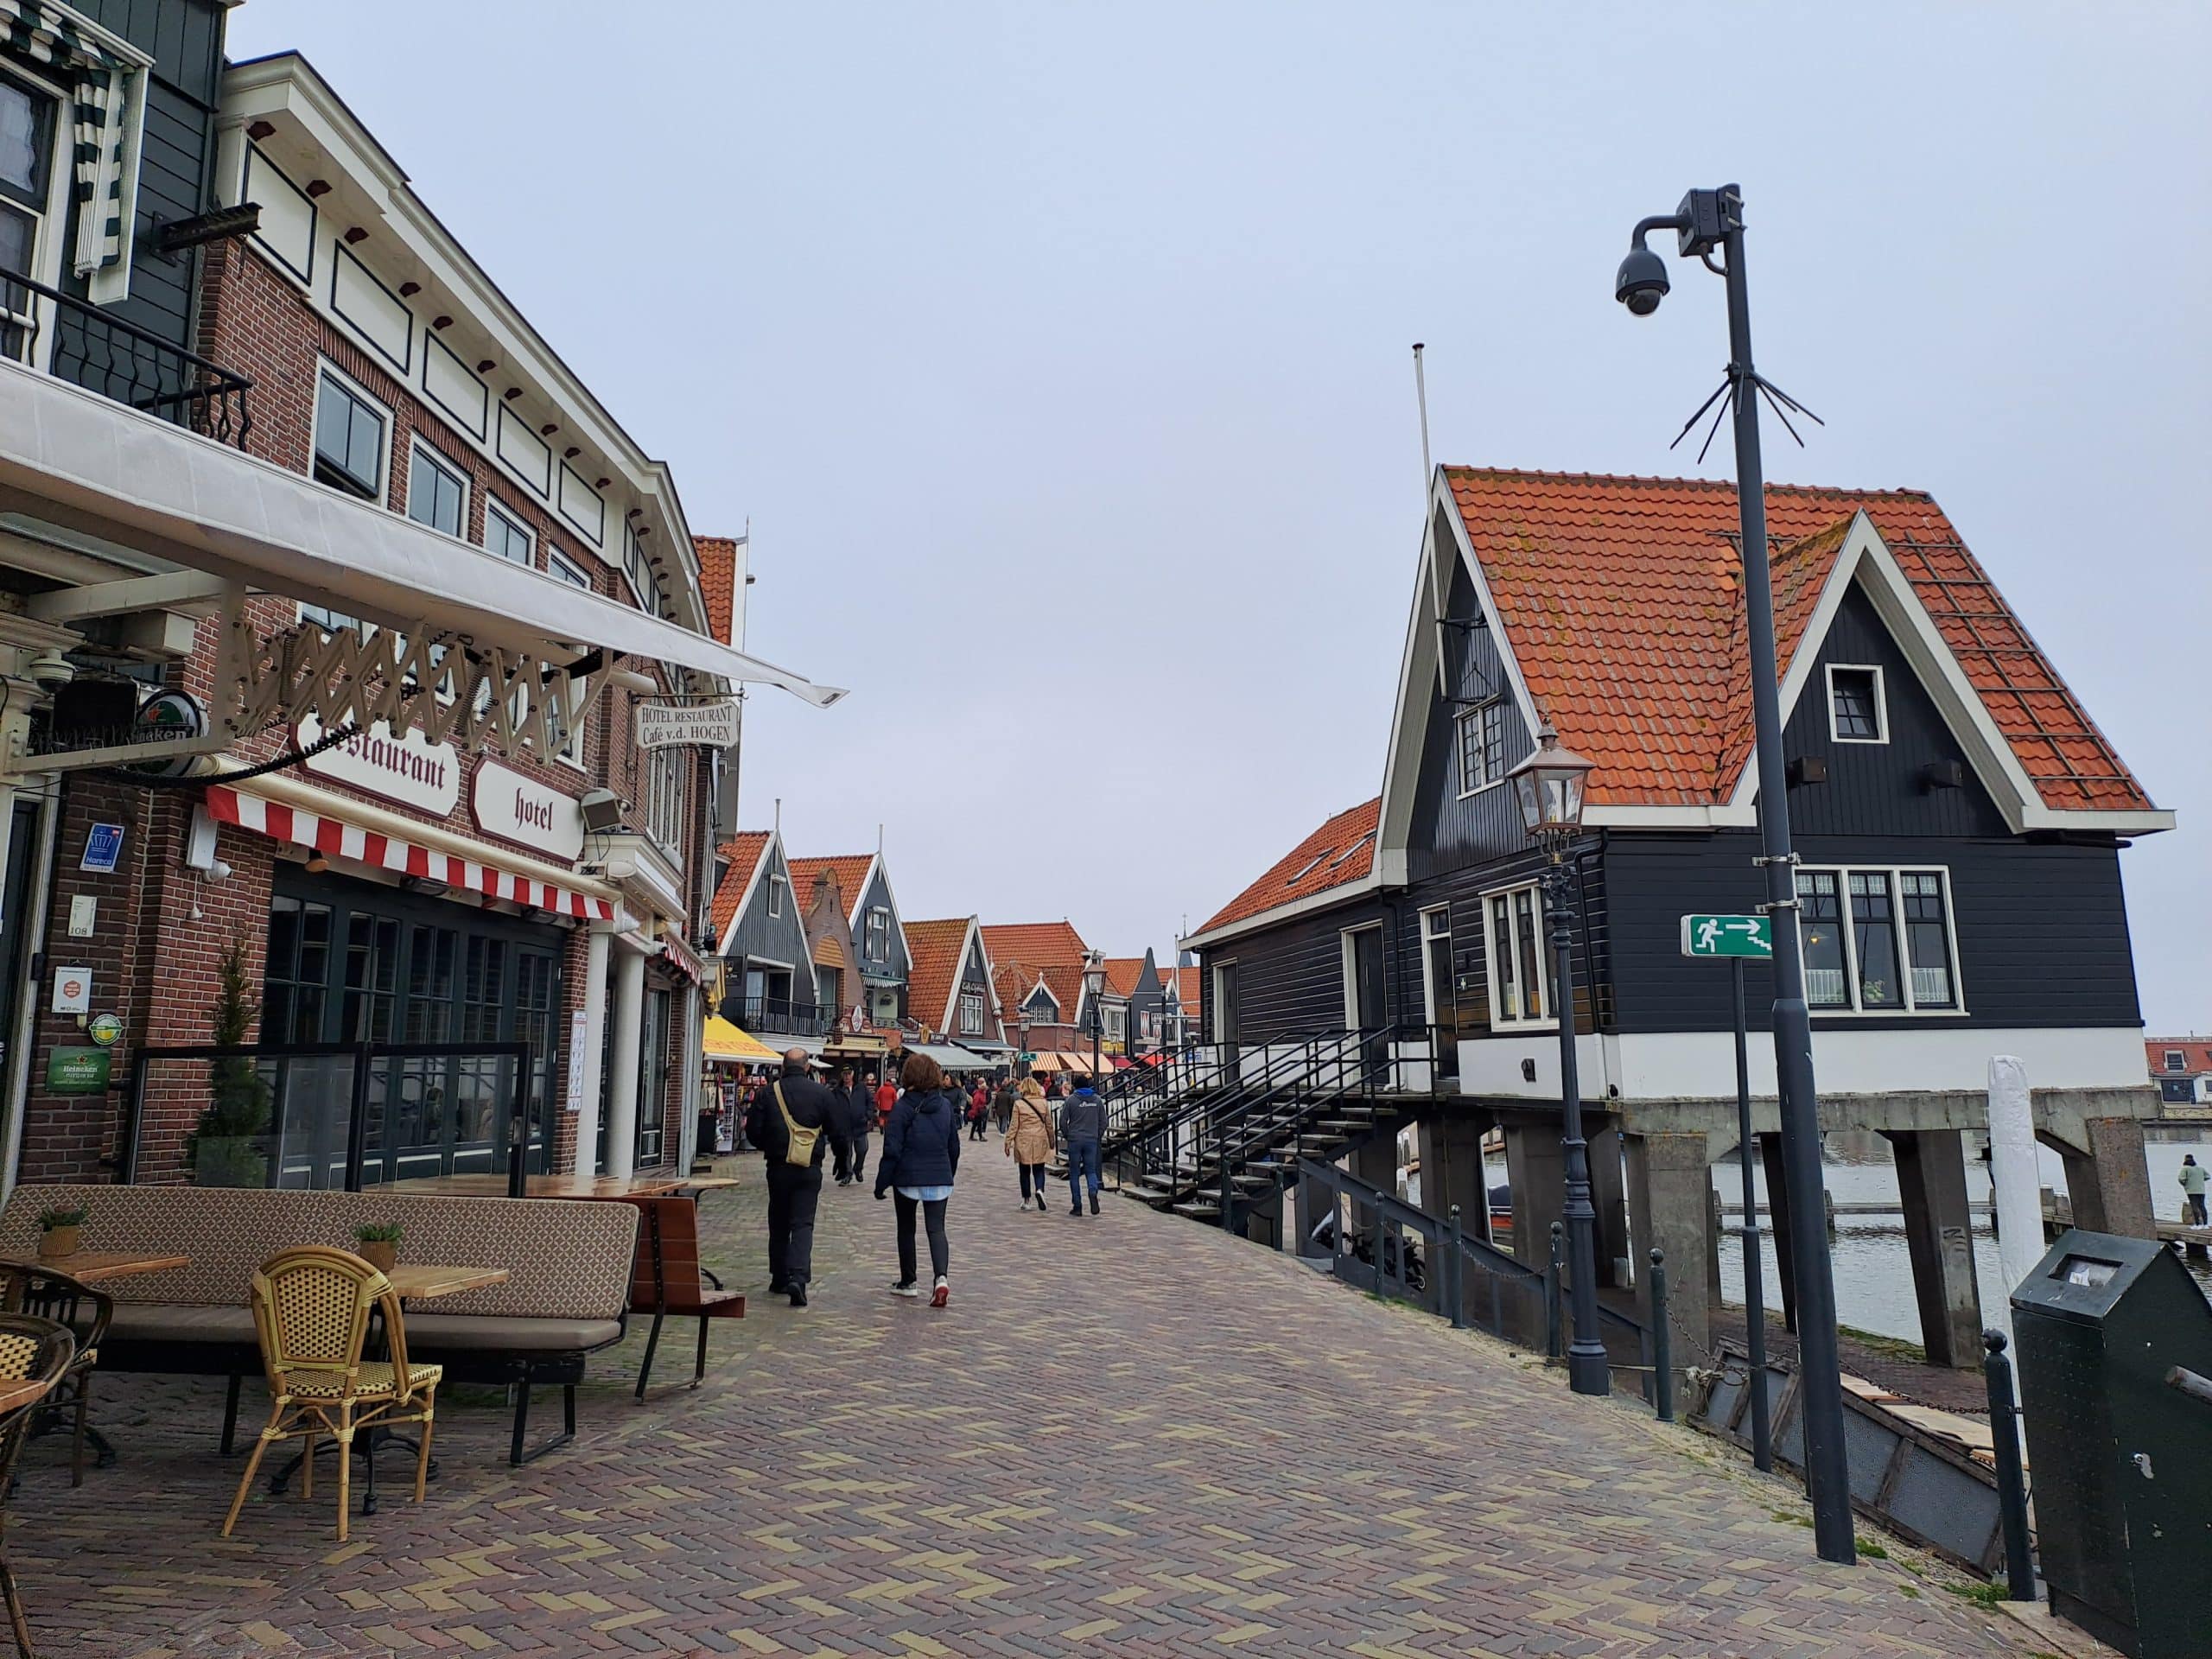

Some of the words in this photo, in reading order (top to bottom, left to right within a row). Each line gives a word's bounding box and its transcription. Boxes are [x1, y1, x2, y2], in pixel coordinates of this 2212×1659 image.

[642, 707, 672, 723] HOTEL
[675, 705, 733, 722] RESTAURANT
[643, 727, 664, 745] Café
[666, 727, 686, 740] v.d.
[691, 726, 730, 741] HOGEN
[515, 787, 554, 831] hotel
[70, 926, 88, 936] 108
